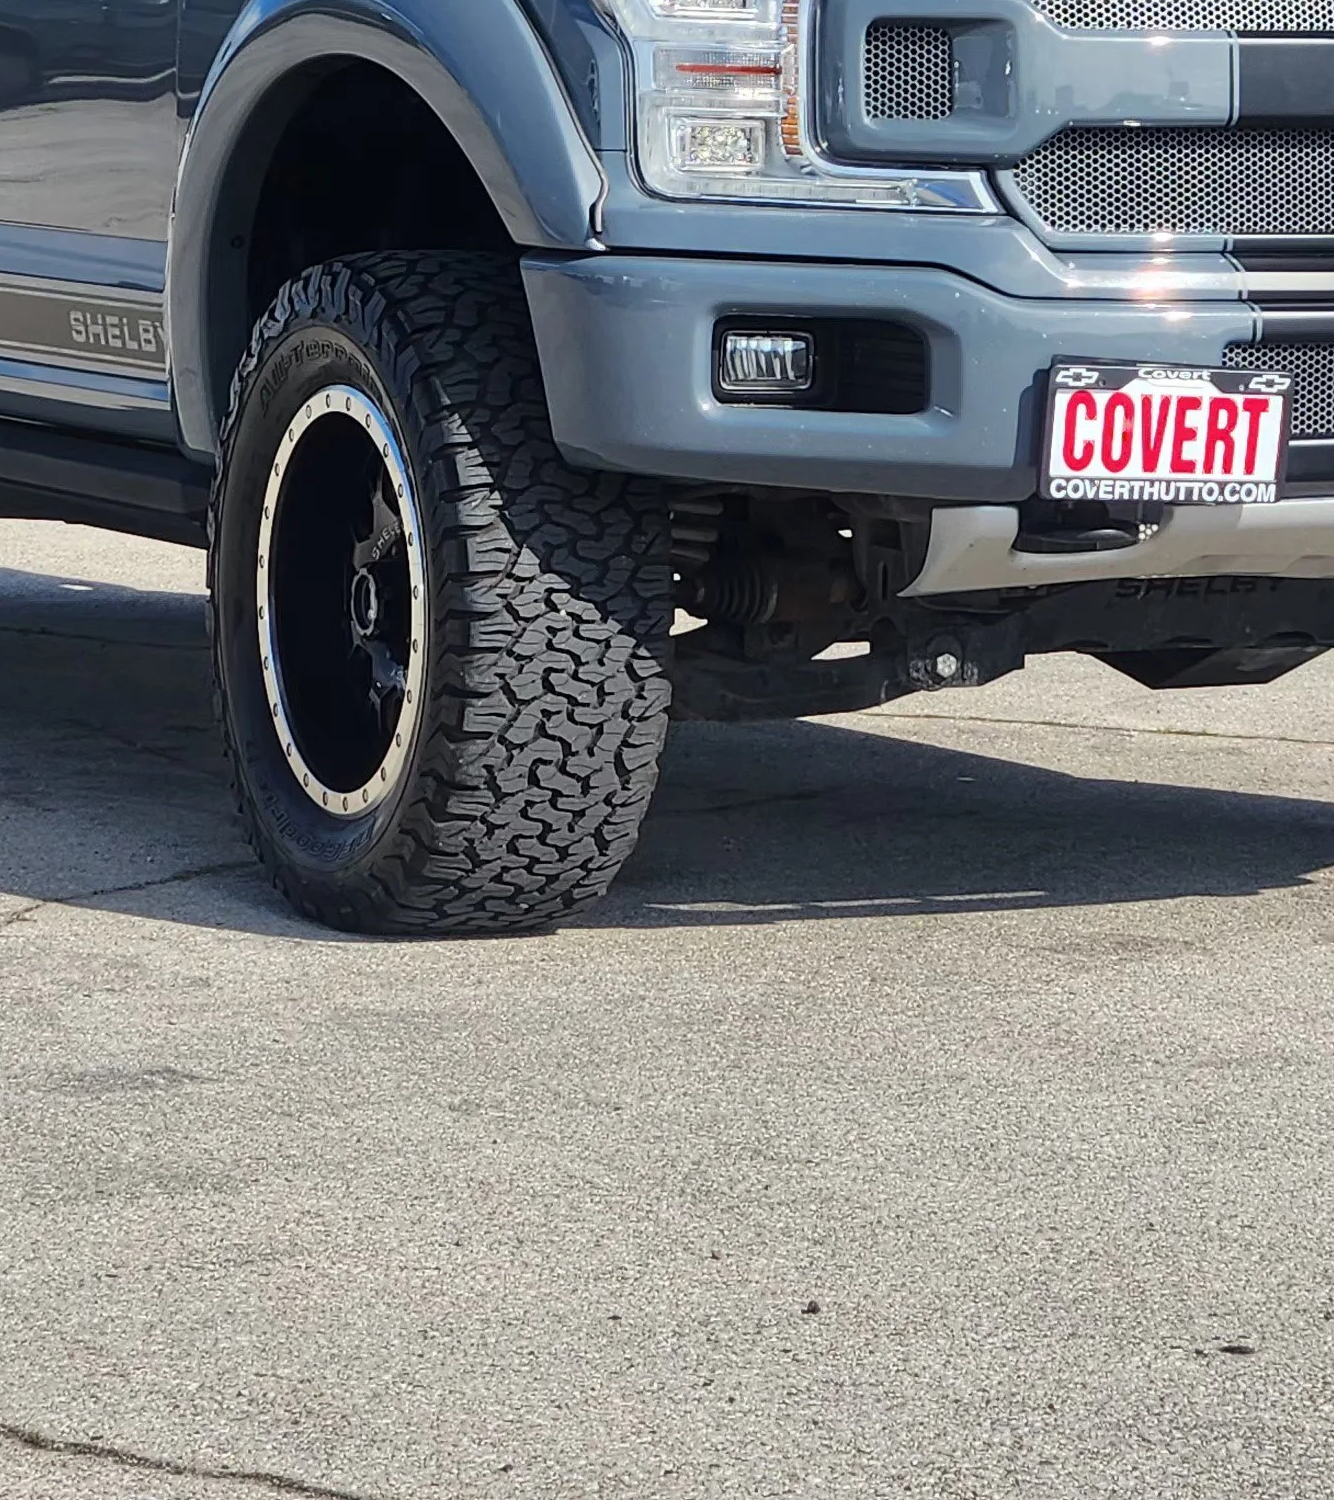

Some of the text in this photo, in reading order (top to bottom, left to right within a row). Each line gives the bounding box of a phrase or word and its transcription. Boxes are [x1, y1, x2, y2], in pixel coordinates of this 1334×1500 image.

[1138, 367, 1212, 382] Covert
[1062, 389, 1271, 476] COVERT
[1049, 477, 1278, 503] COVERTHUTTO.COM
